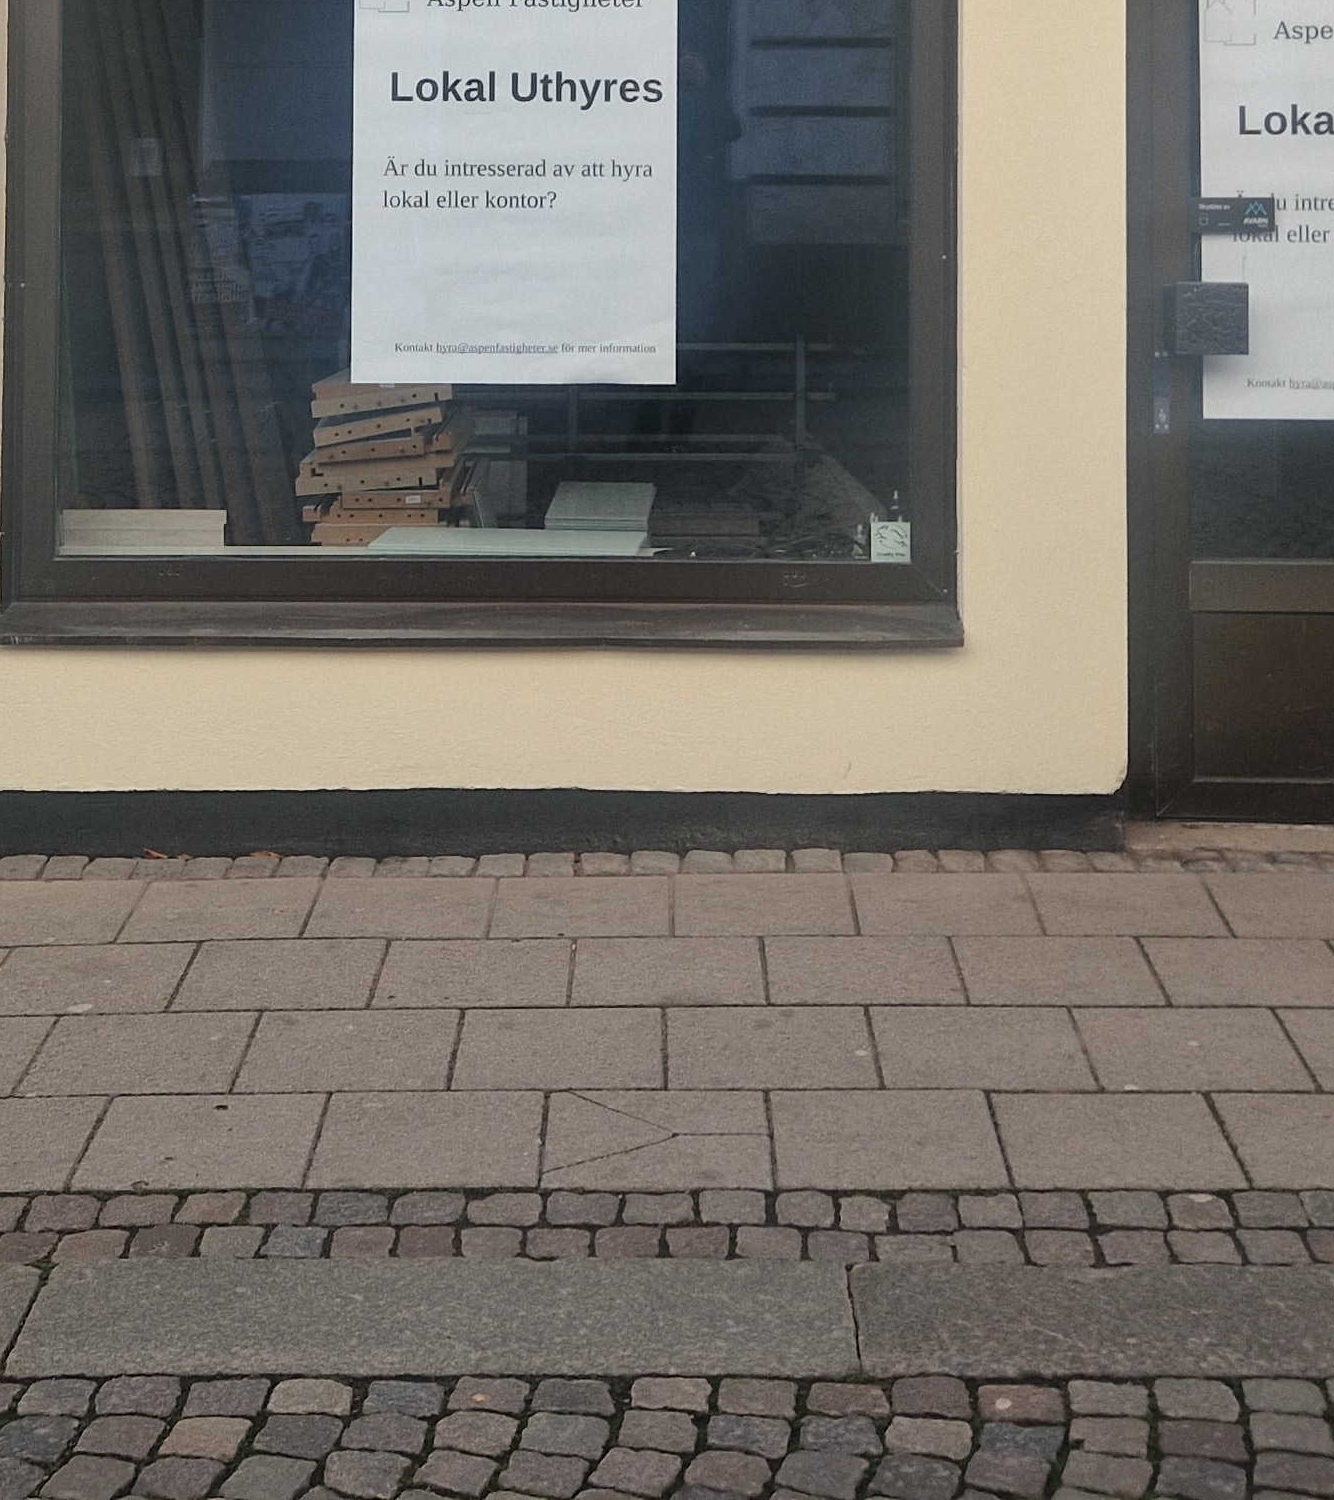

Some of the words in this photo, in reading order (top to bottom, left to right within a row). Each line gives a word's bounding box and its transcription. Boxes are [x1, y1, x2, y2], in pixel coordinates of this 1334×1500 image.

[390, 70, 496, 103] Lokal
[511, 70, 664, 111] Uthyres
[383, 156, 410, 178] Är
[413, 158, 438, 178] du
[443, 158, 547, 178] intresserad
[552, 163, 576, 178] av
[580, 161, 605, 178] att
[610, 158, 653, 183] hyra
[382, 189, 430, 209] lokal
[436, 189, 480, 209] eller
[484, 189, 557, 209] kontor?
[1286, 224, 1331, 243] eller
[394, 342, 433, 353] Kontakt
[561, 342, 575, 353] för
[577, 345, 597, 353] mer
[598, 343, 656, 354] information
[1246, 378, 1287, 389] Kontakt
